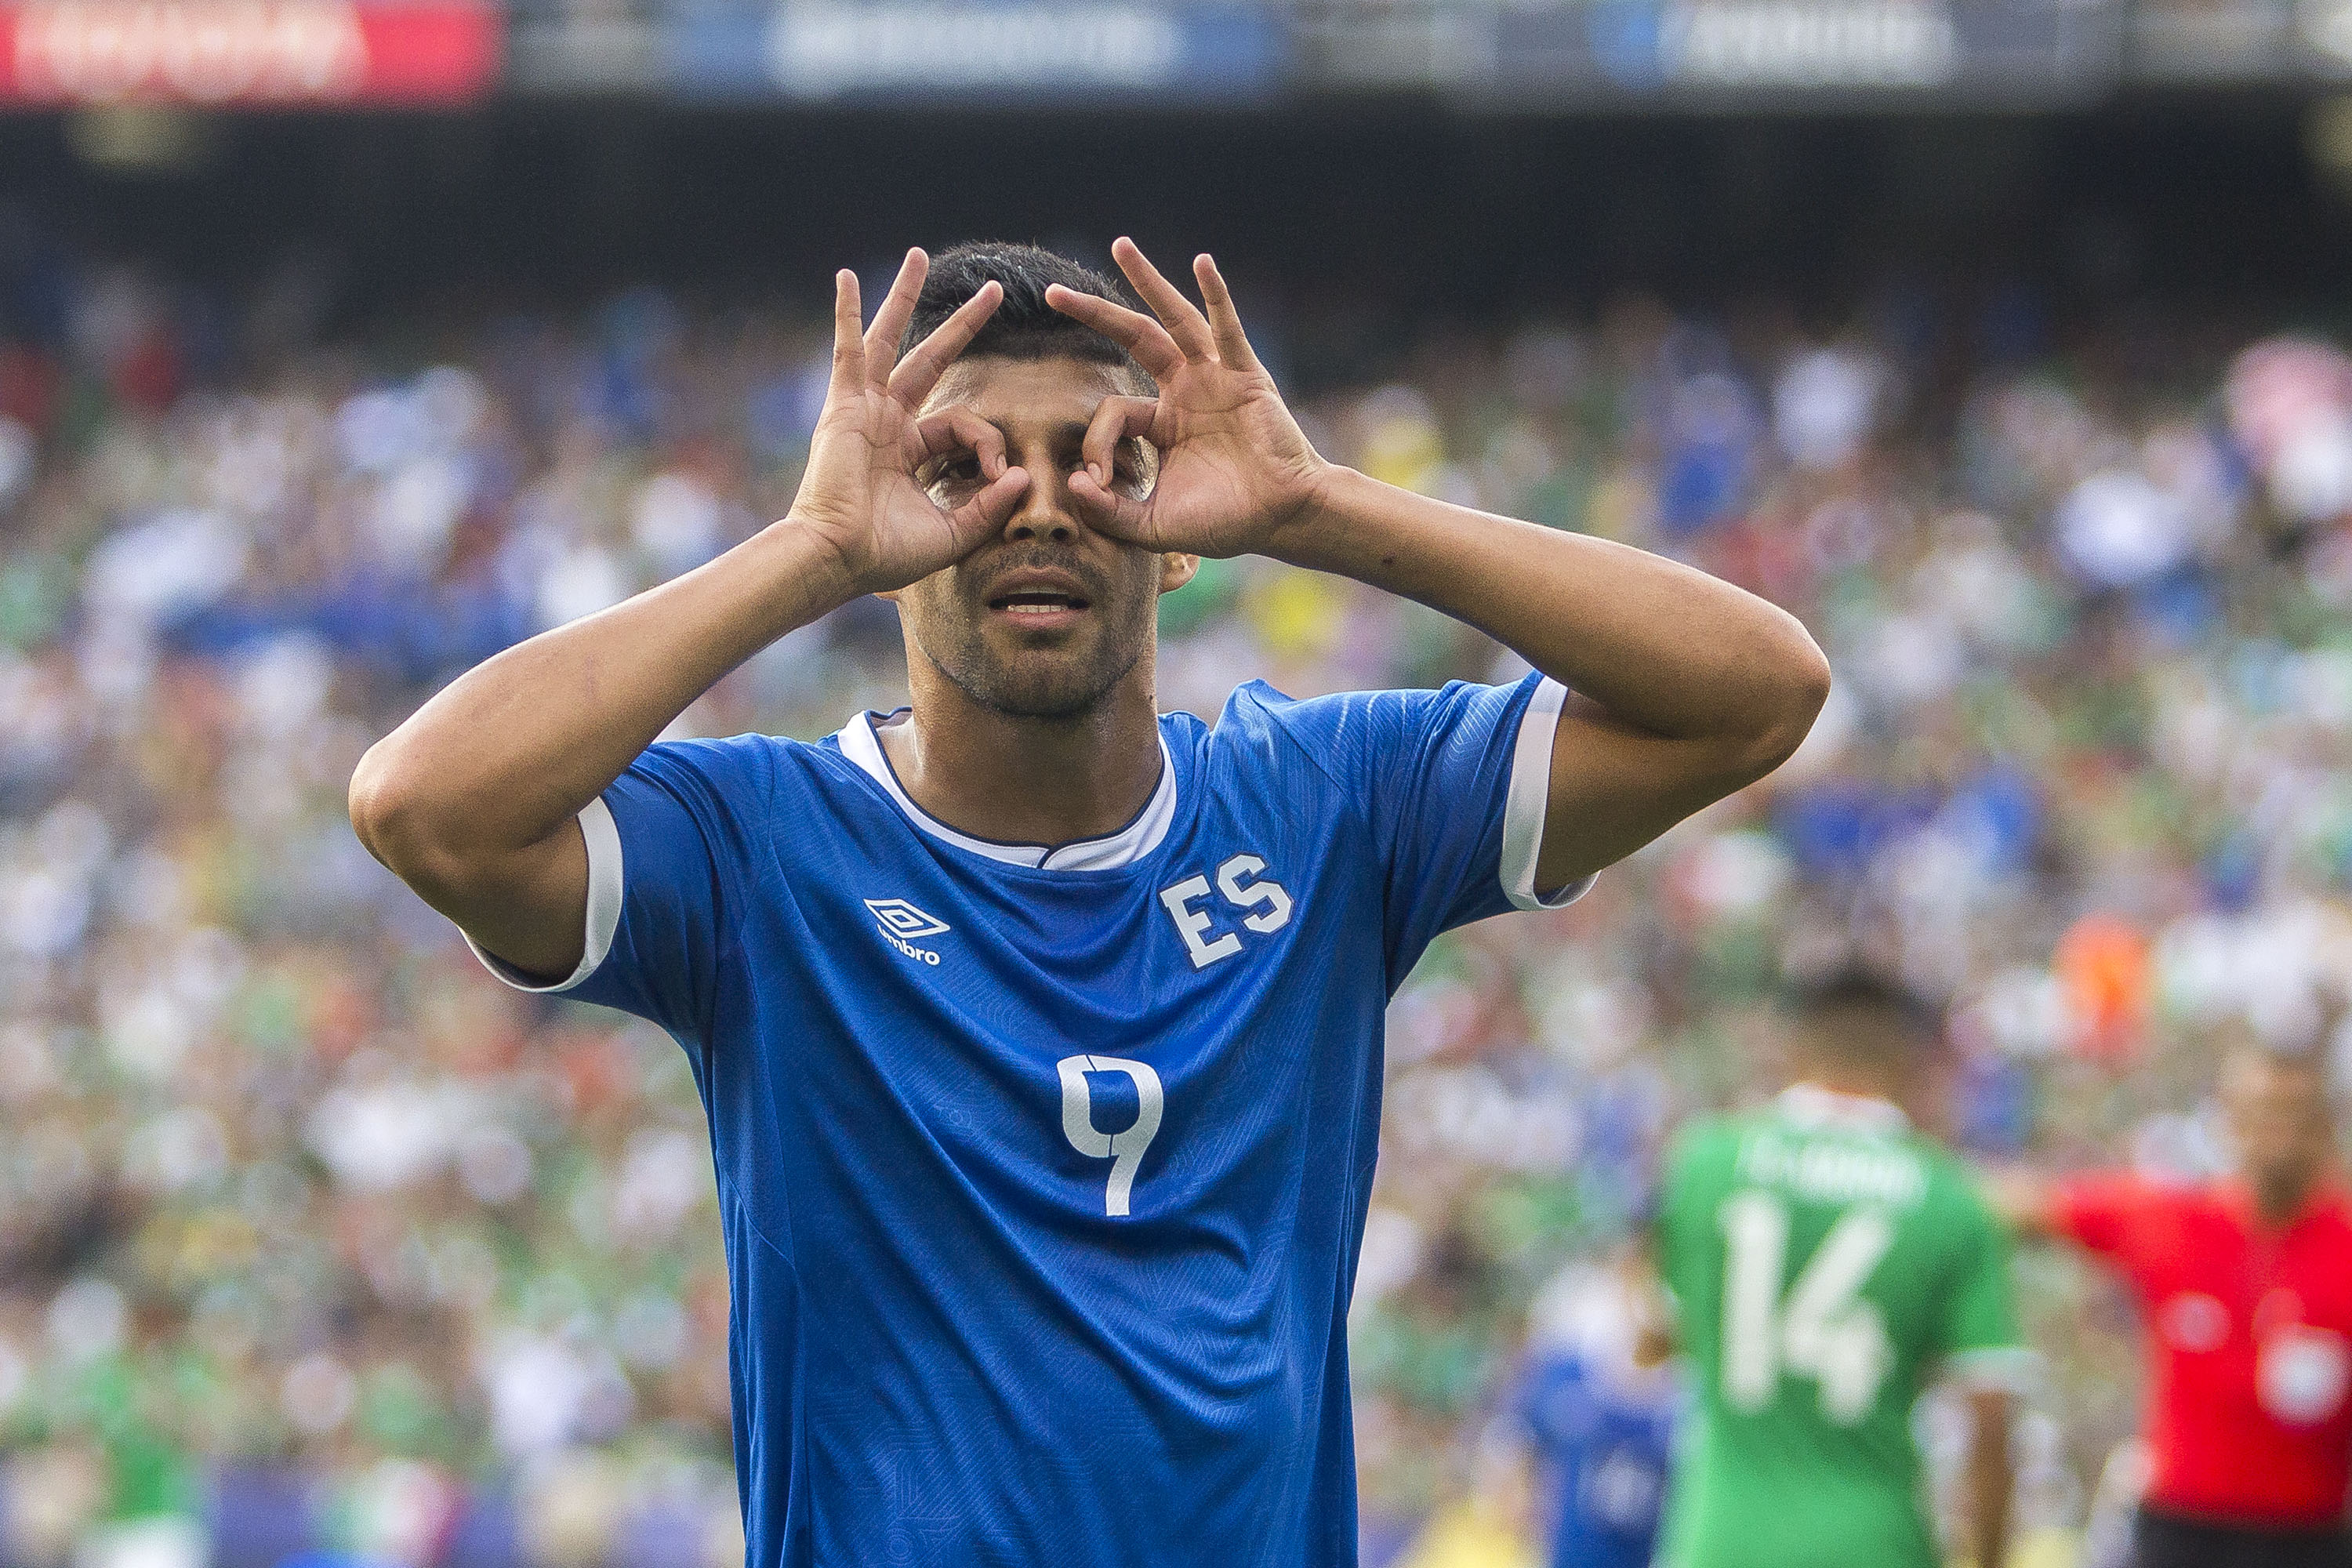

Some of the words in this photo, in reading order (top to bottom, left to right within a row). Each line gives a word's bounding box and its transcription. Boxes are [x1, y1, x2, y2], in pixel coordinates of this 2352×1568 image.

[877, 924, 940, 965] umbro
[1159, 855, 1293, 969] ES
[1056, 1054, 1163, 1217] 9
[1720, 1193, 1891, 1422] 14
